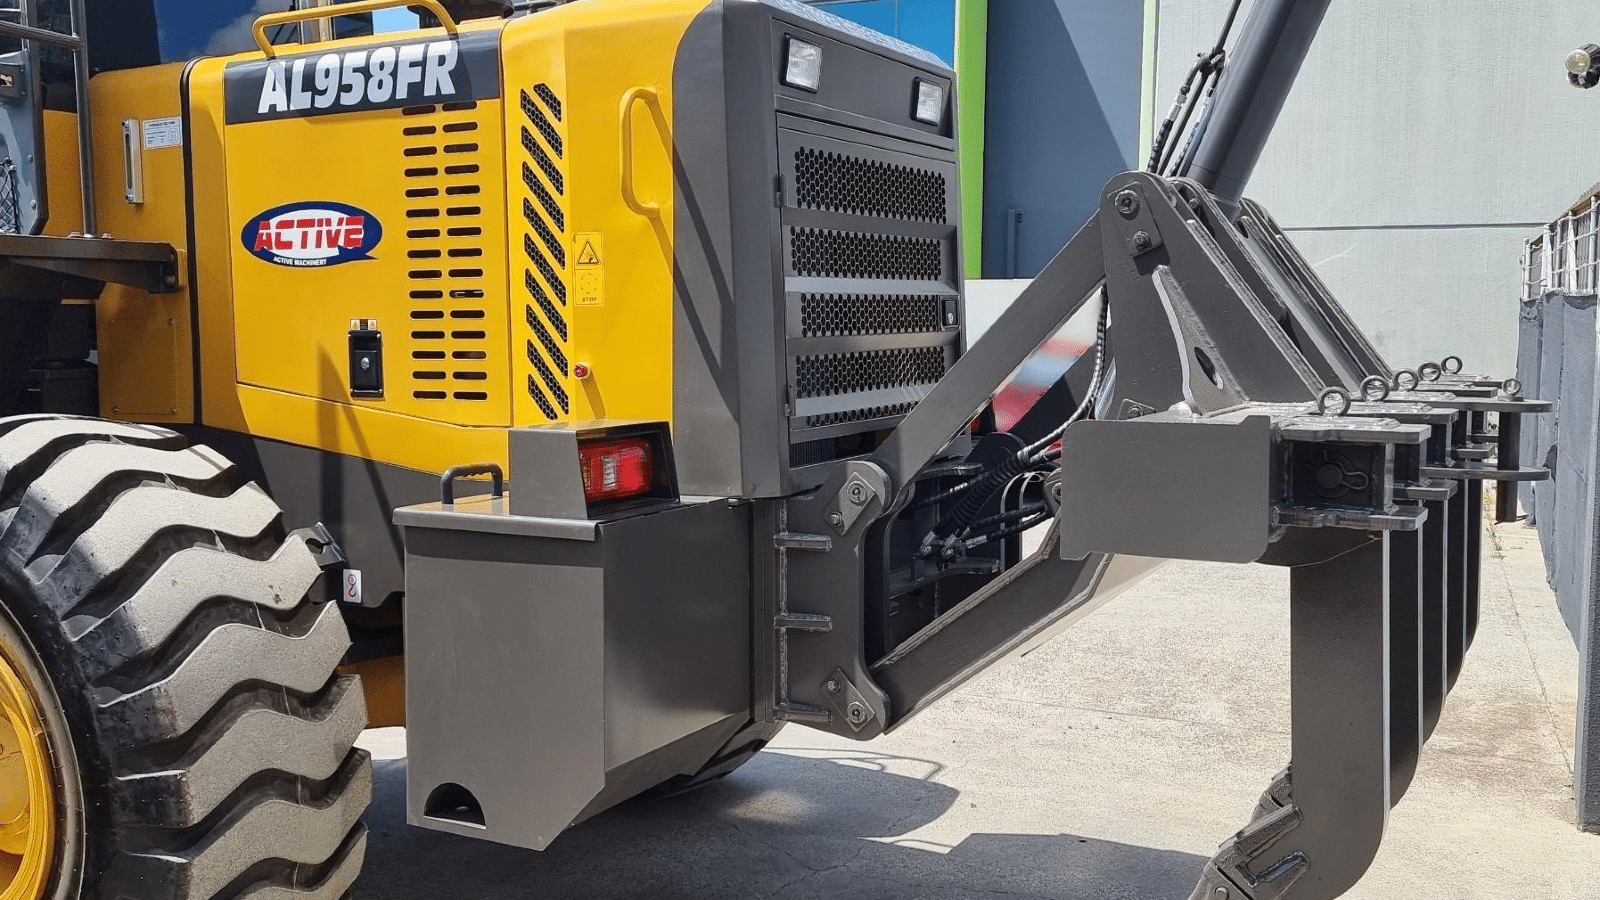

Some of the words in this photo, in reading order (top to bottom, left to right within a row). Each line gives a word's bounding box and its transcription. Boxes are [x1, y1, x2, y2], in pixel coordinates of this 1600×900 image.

[258, 40, 459, 114] AL958FR
[254, 214, 365, 252] ACTIVE
[273, 255, 294, 265] ACTIVE
[294, 258, 327, 267] MACHINERY
